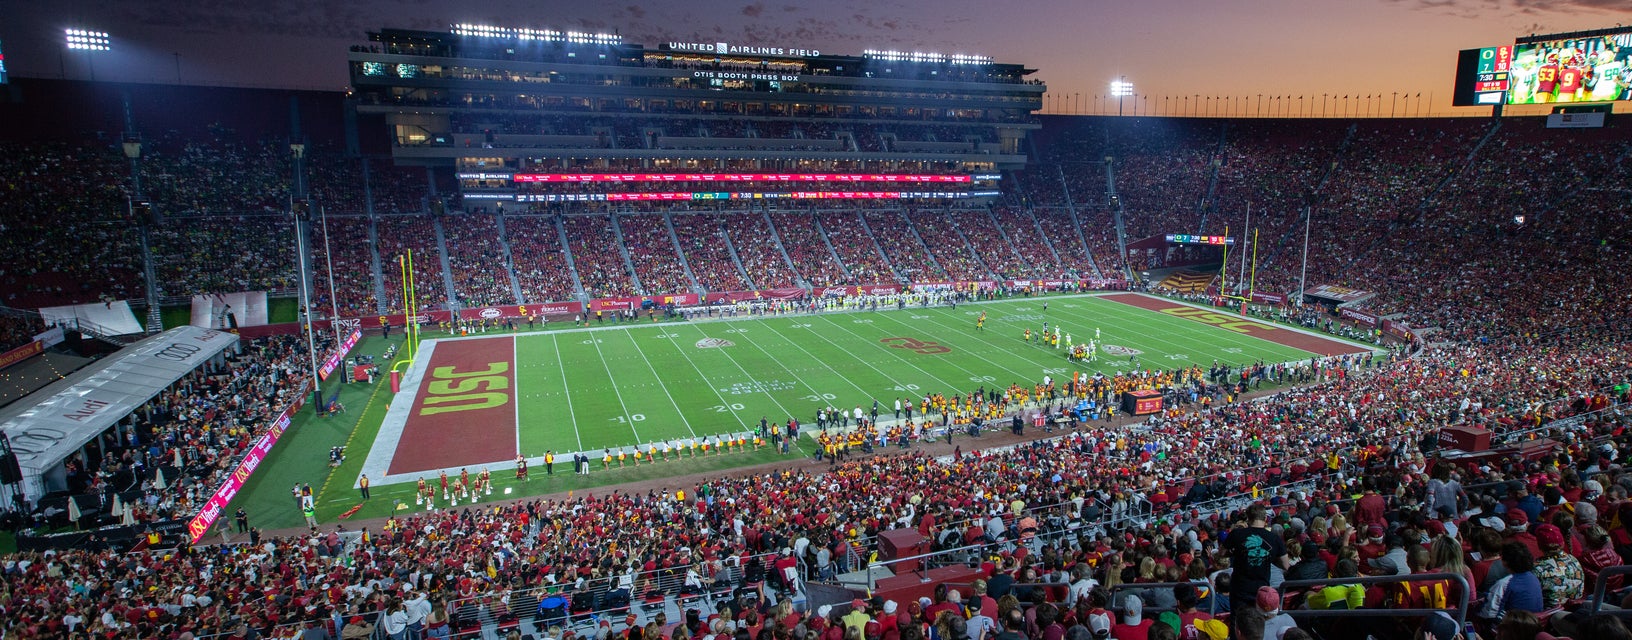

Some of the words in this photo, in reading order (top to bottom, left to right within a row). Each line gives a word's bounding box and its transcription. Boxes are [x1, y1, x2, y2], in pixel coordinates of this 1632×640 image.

[669, 42, 714, 50] UNITED
[730, 45, 784, 54] AIRLINES
[789, 48, 820, 57] FIELD
[1539, 68, 1556, 82] 53
[1564, 72, 1574, 87] 9
[519, 306, 527, 316] SC
[1342, 310, 1375, 324] POWERADE
[1160, 307, 1278, 333] USC
[420, 362, 509, 416] USC
[806, 393, 837, 401] 30
[62, 399, 110, 422] Audi
[714, 403, 745, 413] 20
[616, 414, 646, 424] 10
[235, 464, 249, 484] USC
[244, 454, 260, 472] Viterbi
[190, 515, 207, 538] USC
[201, 500, 220, 524] Viterbi
[1419, 582, 1447, 609] 14
